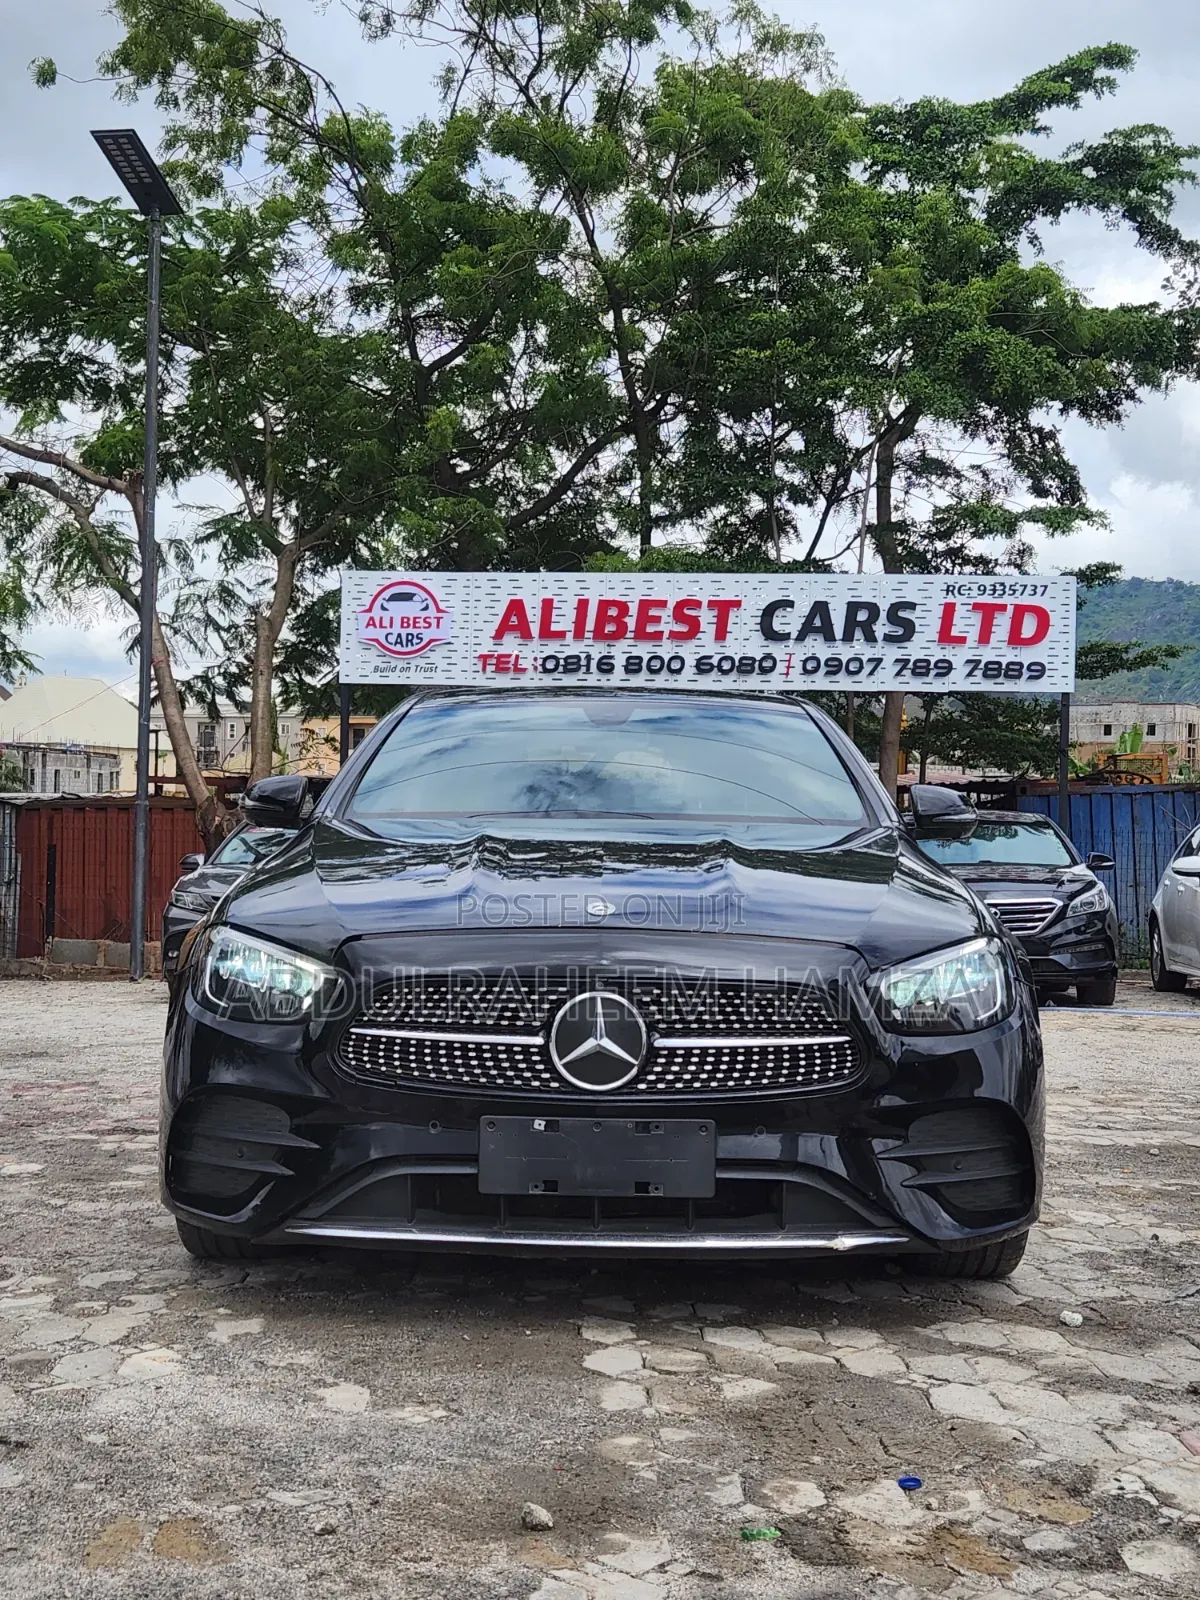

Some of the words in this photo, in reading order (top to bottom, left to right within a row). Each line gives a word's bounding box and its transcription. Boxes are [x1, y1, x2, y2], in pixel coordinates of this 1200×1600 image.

[945, 584, 971, 596] RC:
[977, 584, 1048, 597] 9335737
[365, 616, 394, 629] ALI
[400, 616, 444, 630] BEST
[492, 598, 742, 642] ALIBEST
[760, 598, 917, 644] CARS
[937, 602, 1051, 647] LTD
[384, 632, 424, 648] CARS
[373, 665, 397, 673] Build
[414, 665, 438, 673] Trust
[624, 655, 685, 674] 800
[695, 655, 777, 675] 6080
[802, 656, 884, 677] 0907
[893, 658, 953, 679] 789
[963, 659, 1047, 681] 7889
